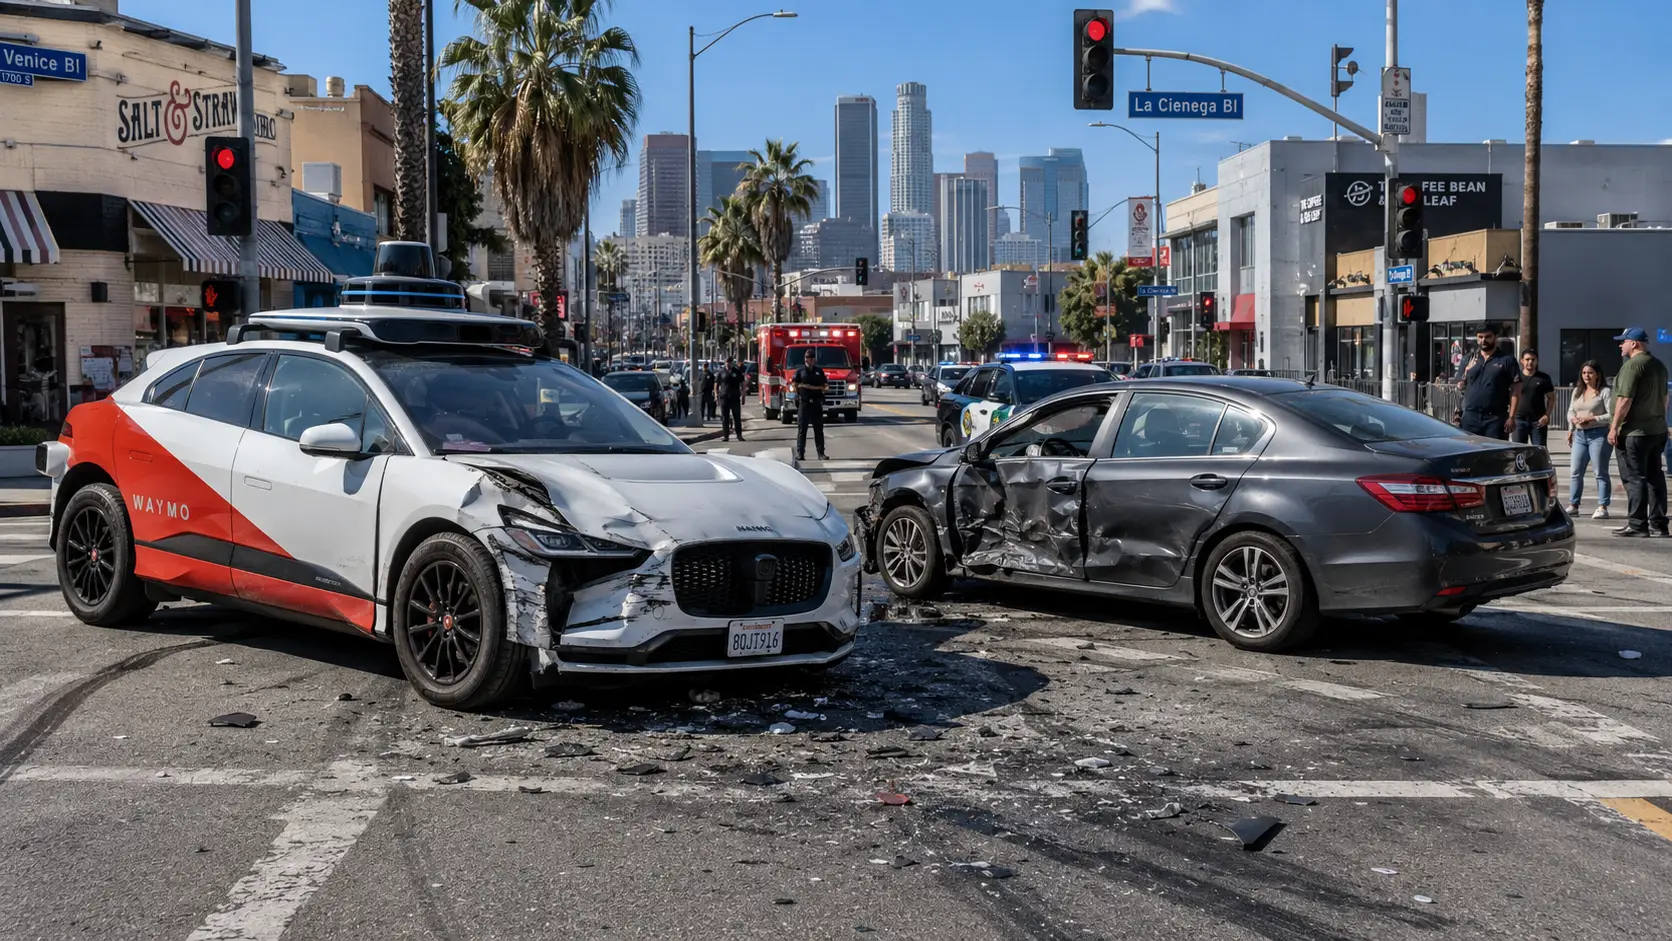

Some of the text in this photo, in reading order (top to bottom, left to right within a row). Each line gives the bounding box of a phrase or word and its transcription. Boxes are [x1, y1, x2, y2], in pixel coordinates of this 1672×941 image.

[3, 48, 80, 74] Venice Bl
[2, 72, 31, 85] 1700 S
[118, 99, 162, 143] SALT
[164, 80, 192, 146] &
[1135, 97, 1238, 116] La Cienega Bl
[1449, 181, 1487, 193] BEAN
[1423, 195, 1457, 206] LEAF
[132, 493, 190, 521] WAYMO
